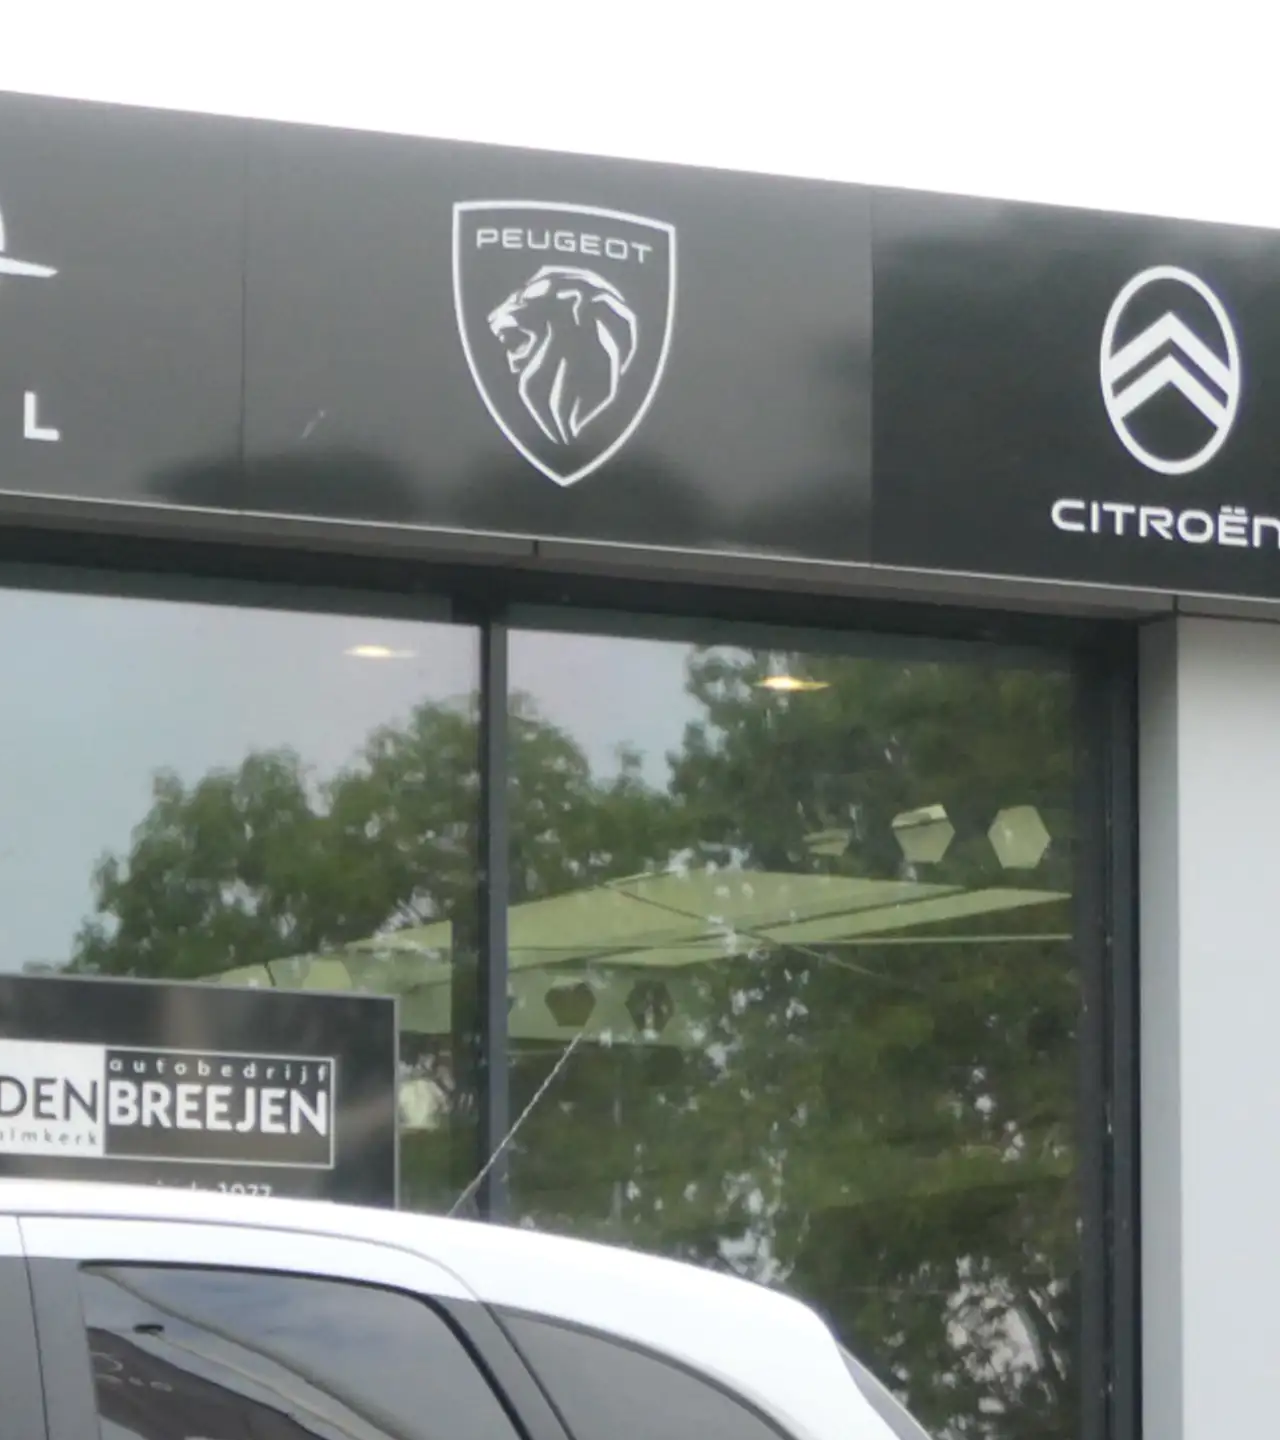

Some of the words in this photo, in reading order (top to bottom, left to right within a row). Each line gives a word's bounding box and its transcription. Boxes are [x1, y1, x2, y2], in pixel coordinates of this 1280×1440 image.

[476, 227, 653, 263] PEUGEOT
[109, 1056, 331, 1083] autobedrijf
[107, 1080, 329, 1138] BREEJEN
